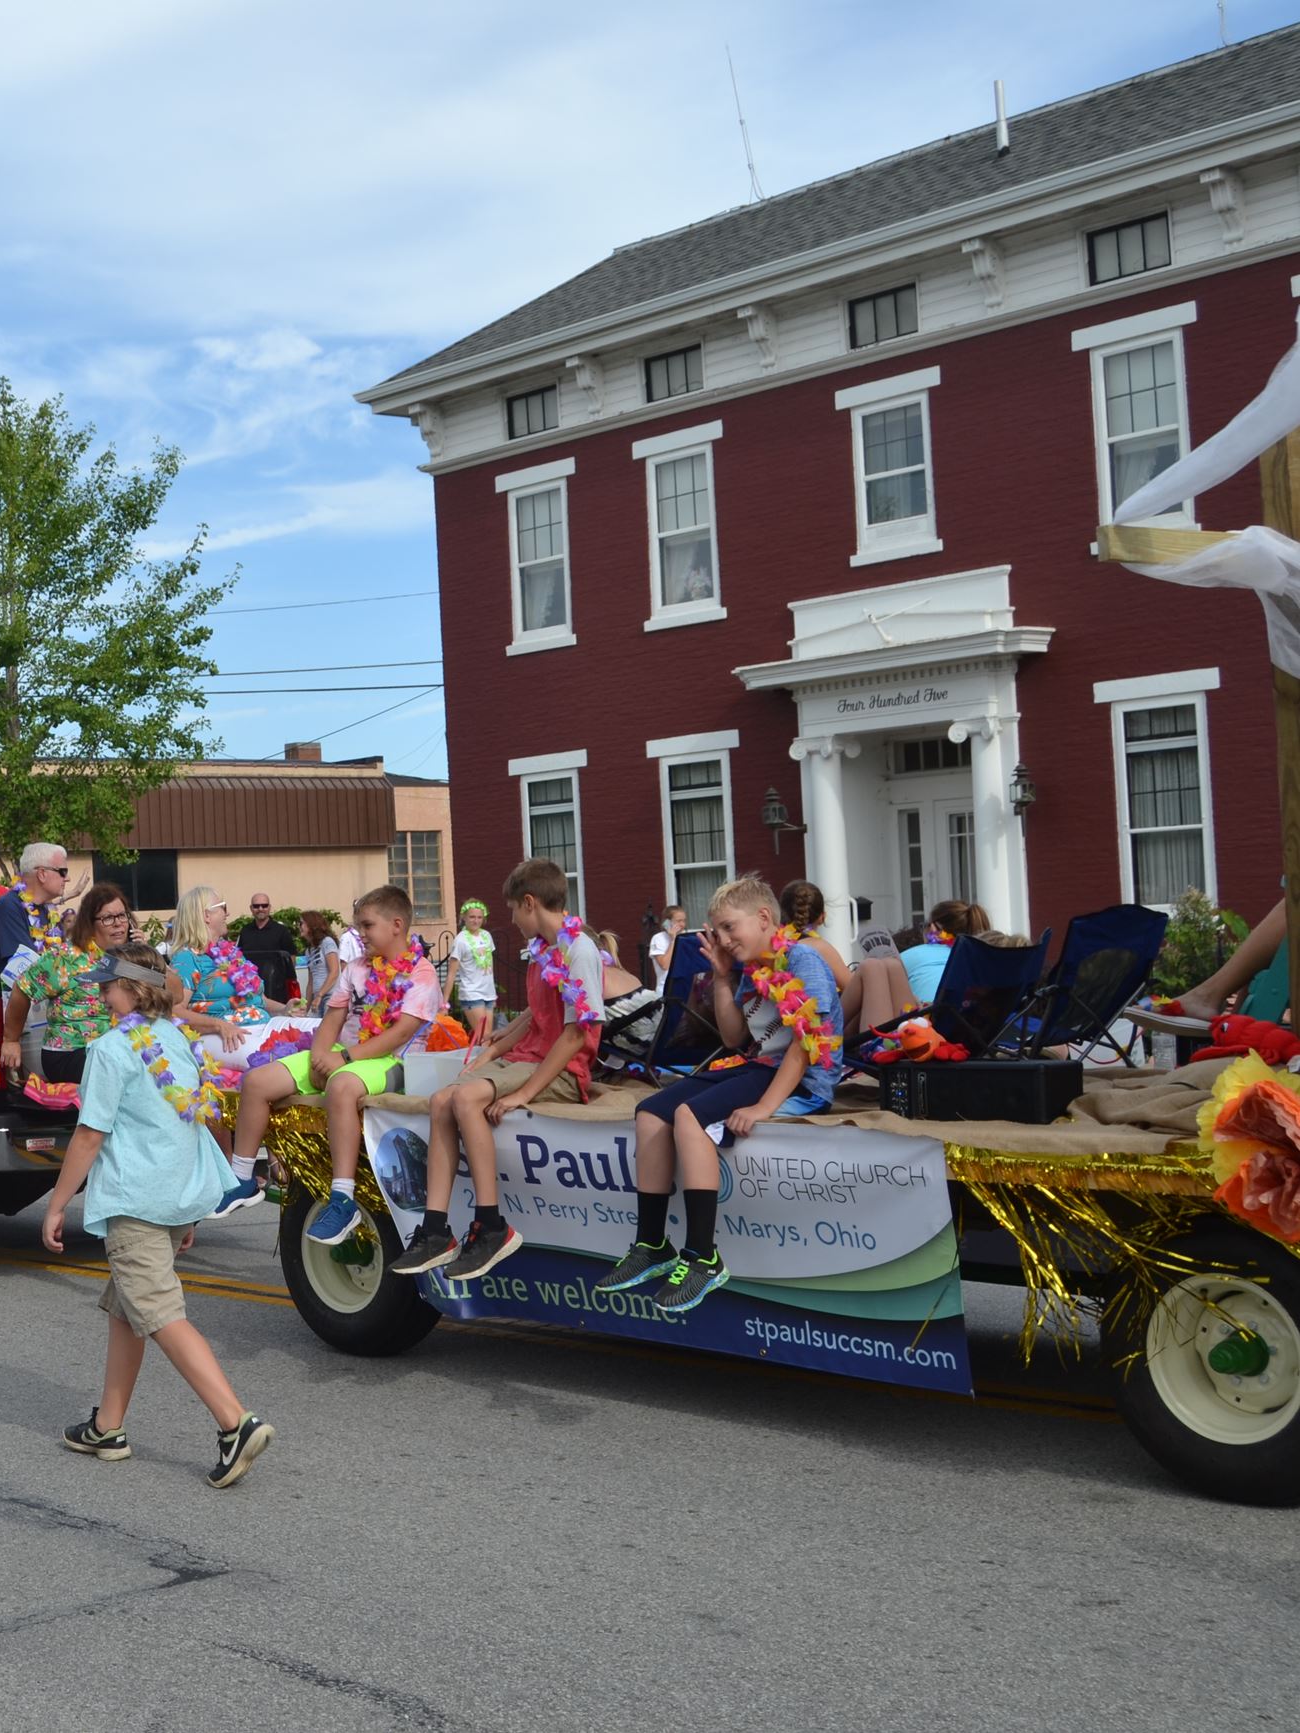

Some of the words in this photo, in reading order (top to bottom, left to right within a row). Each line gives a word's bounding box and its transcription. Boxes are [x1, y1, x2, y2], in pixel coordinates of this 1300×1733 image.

[837, 699, 865, 713] Four
[869, 689, 920, 709] Hundred
[923, 687, 948, 702] Five
[516, 1134, 677, 1197] Paul
[734, 1156, 816, 1181] UNITED
[824, 1161, 927, 1188] CHURCH
[739, 1178, 770, 1199] OF
[777, 1181, 857, 1204] CHRIST
[506, 1193, 530, 1215] N.
[536, 1196, 589, 1227] Perry
[593, 1202, 638, 1226] Stre
[723, 1214, 809, 1247] Marys,
[815, 1220, 877, 1251] Ohio
[482, 1275, 529, 1302] are
[744, 1317, 957, 1370] stpaulsuccsm.com
